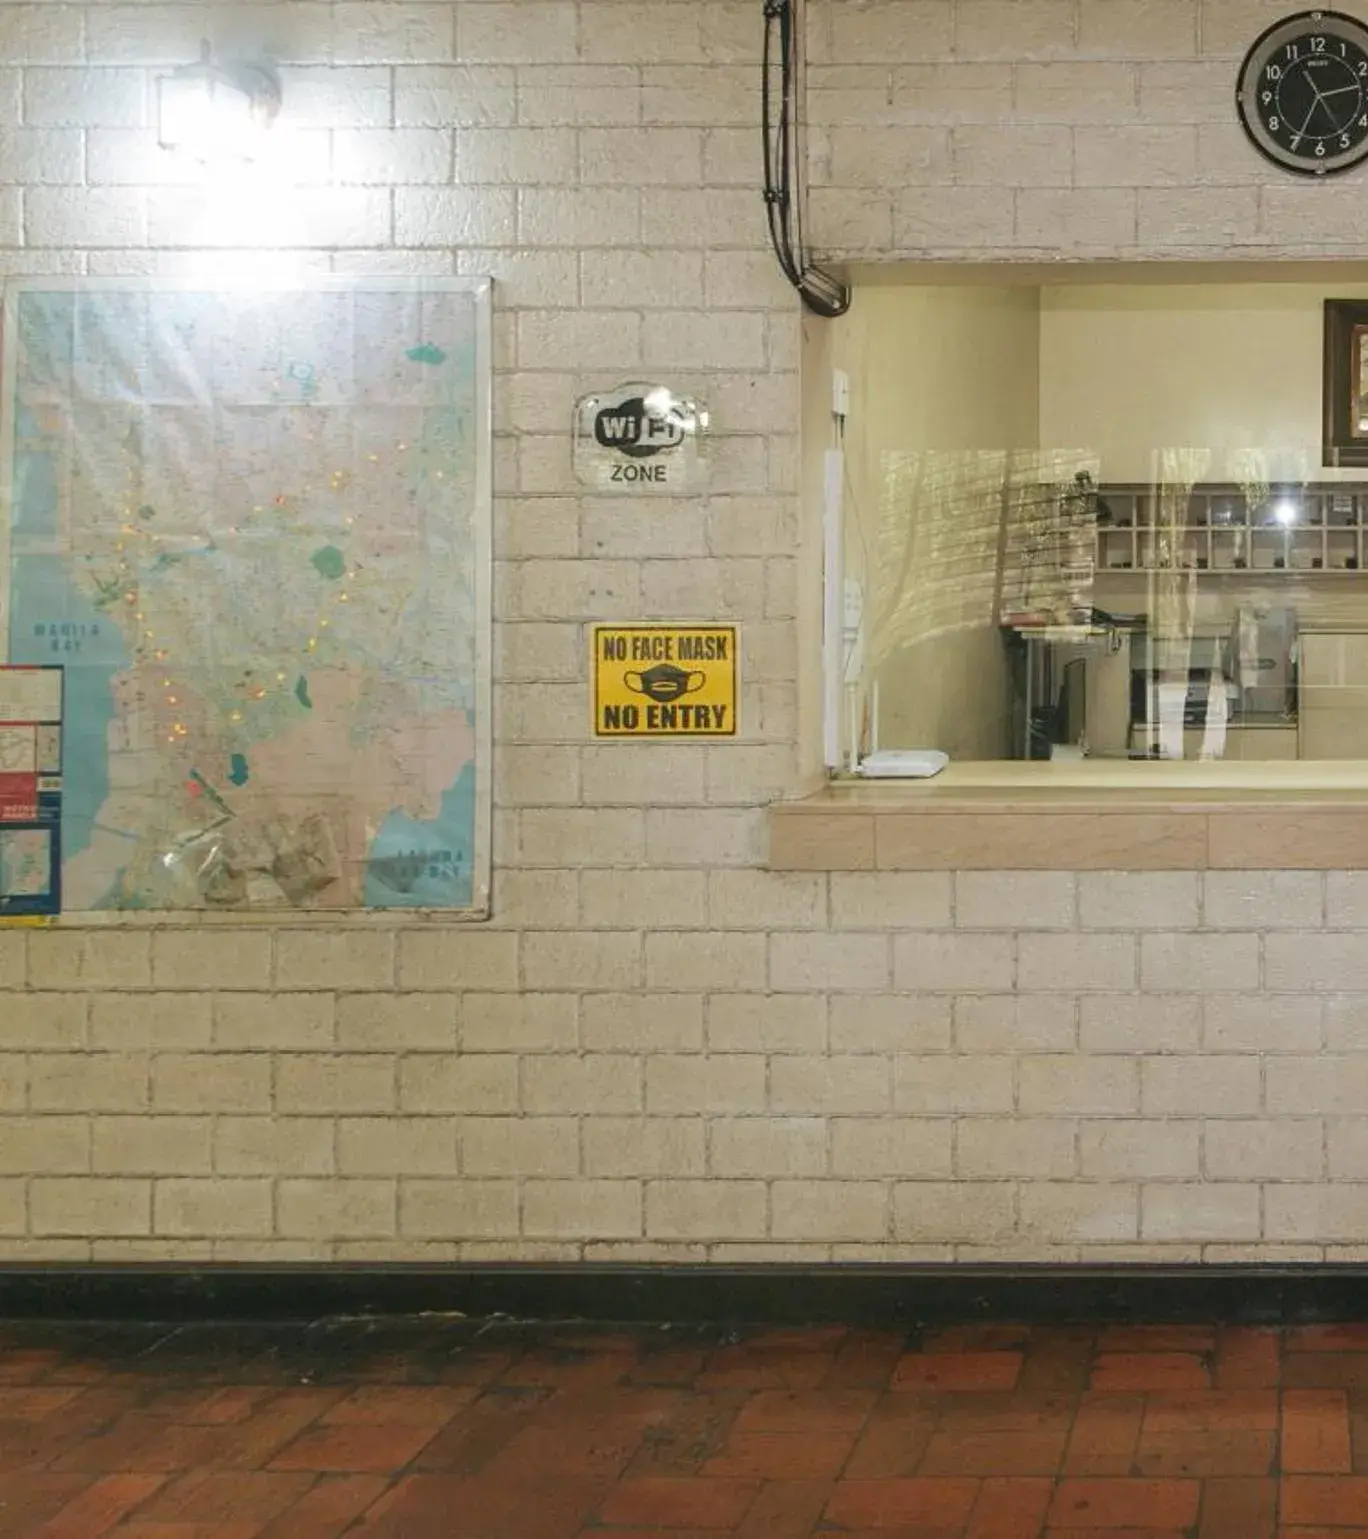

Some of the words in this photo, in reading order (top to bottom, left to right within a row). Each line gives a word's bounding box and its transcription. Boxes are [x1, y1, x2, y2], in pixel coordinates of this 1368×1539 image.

[1286, 45, 1298, 59] 11
[1310, 37, 1325, 52] 12
[1340, 43, 1346, 57] 1
[1266, 65, 1281, 80] 10
[1358, 61, 1368, 76] 2
[1262, 91, 1272, 105] 9
[1269, 117, 1279, 131] 8
[1358, 114, 1368, 127] 4
[1289, 136, 1300, 151] 7
[1315, 141, 1325, 156] 6
[1340, 134, 1350, 148] 5
[610, 464, 667, 482] ZONE
[603, 636, 627, 661] NO
[632, 636, 674, 661] FACE
[678, 636, 728, 661] MASK
[604, 704, 639, 729] NO
[646, 704, 727, 729] ENTRY
